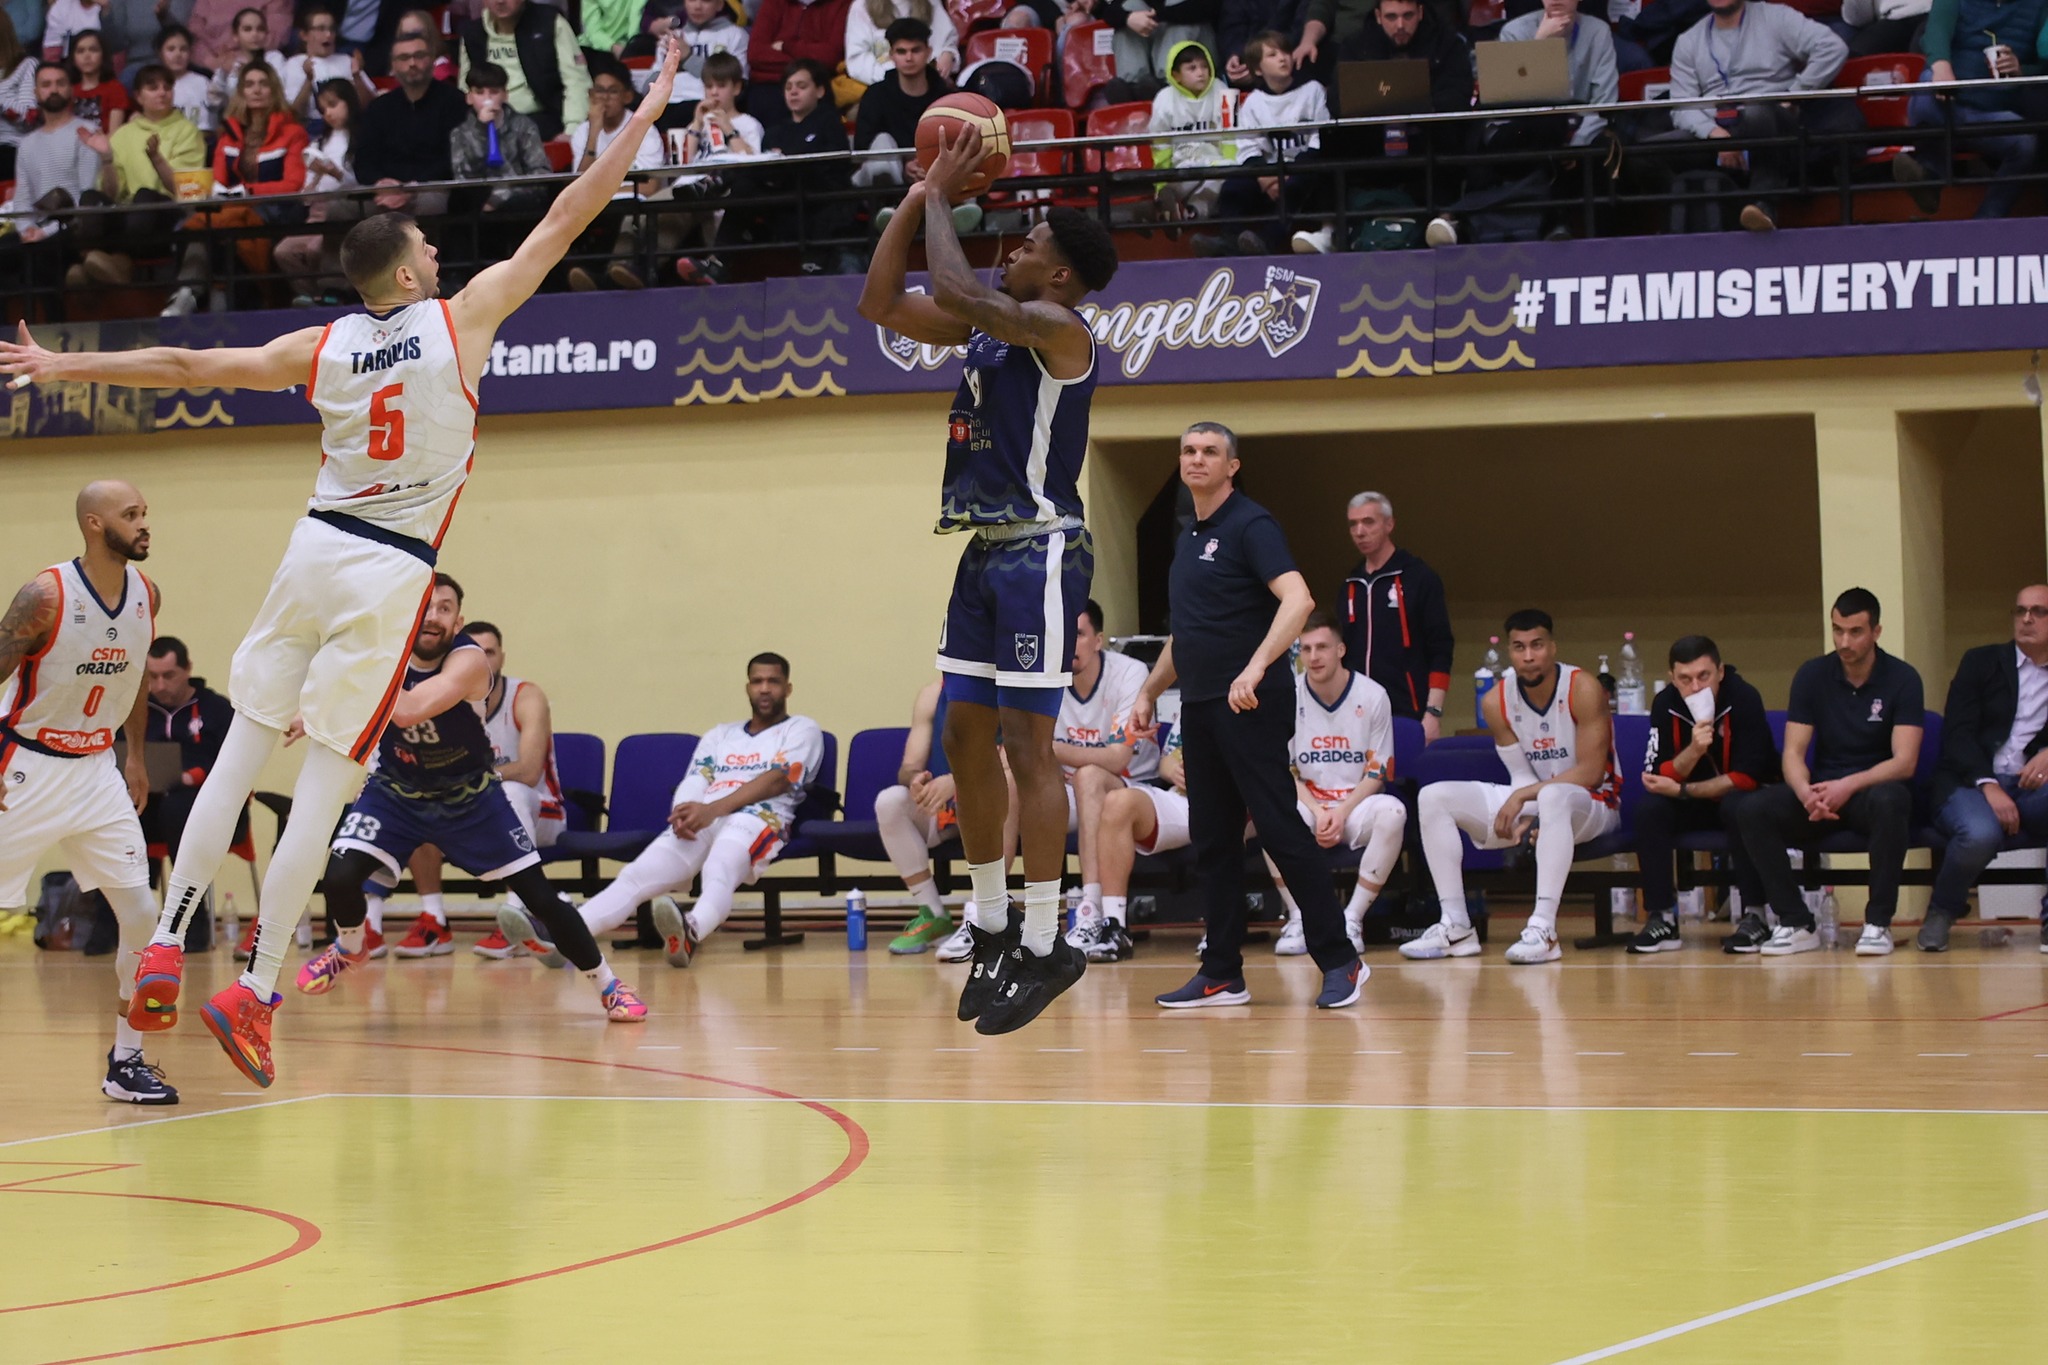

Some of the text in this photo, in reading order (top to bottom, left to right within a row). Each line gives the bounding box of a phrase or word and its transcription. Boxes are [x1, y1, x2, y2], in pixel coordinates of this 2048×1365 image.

[1513, 254, 2048, 328] #TEAMISEVERYTHIN
[367, 382, 405, 460] 5
[83, 685, 105, 717] 0
[338, 812, 381, 841] 33
